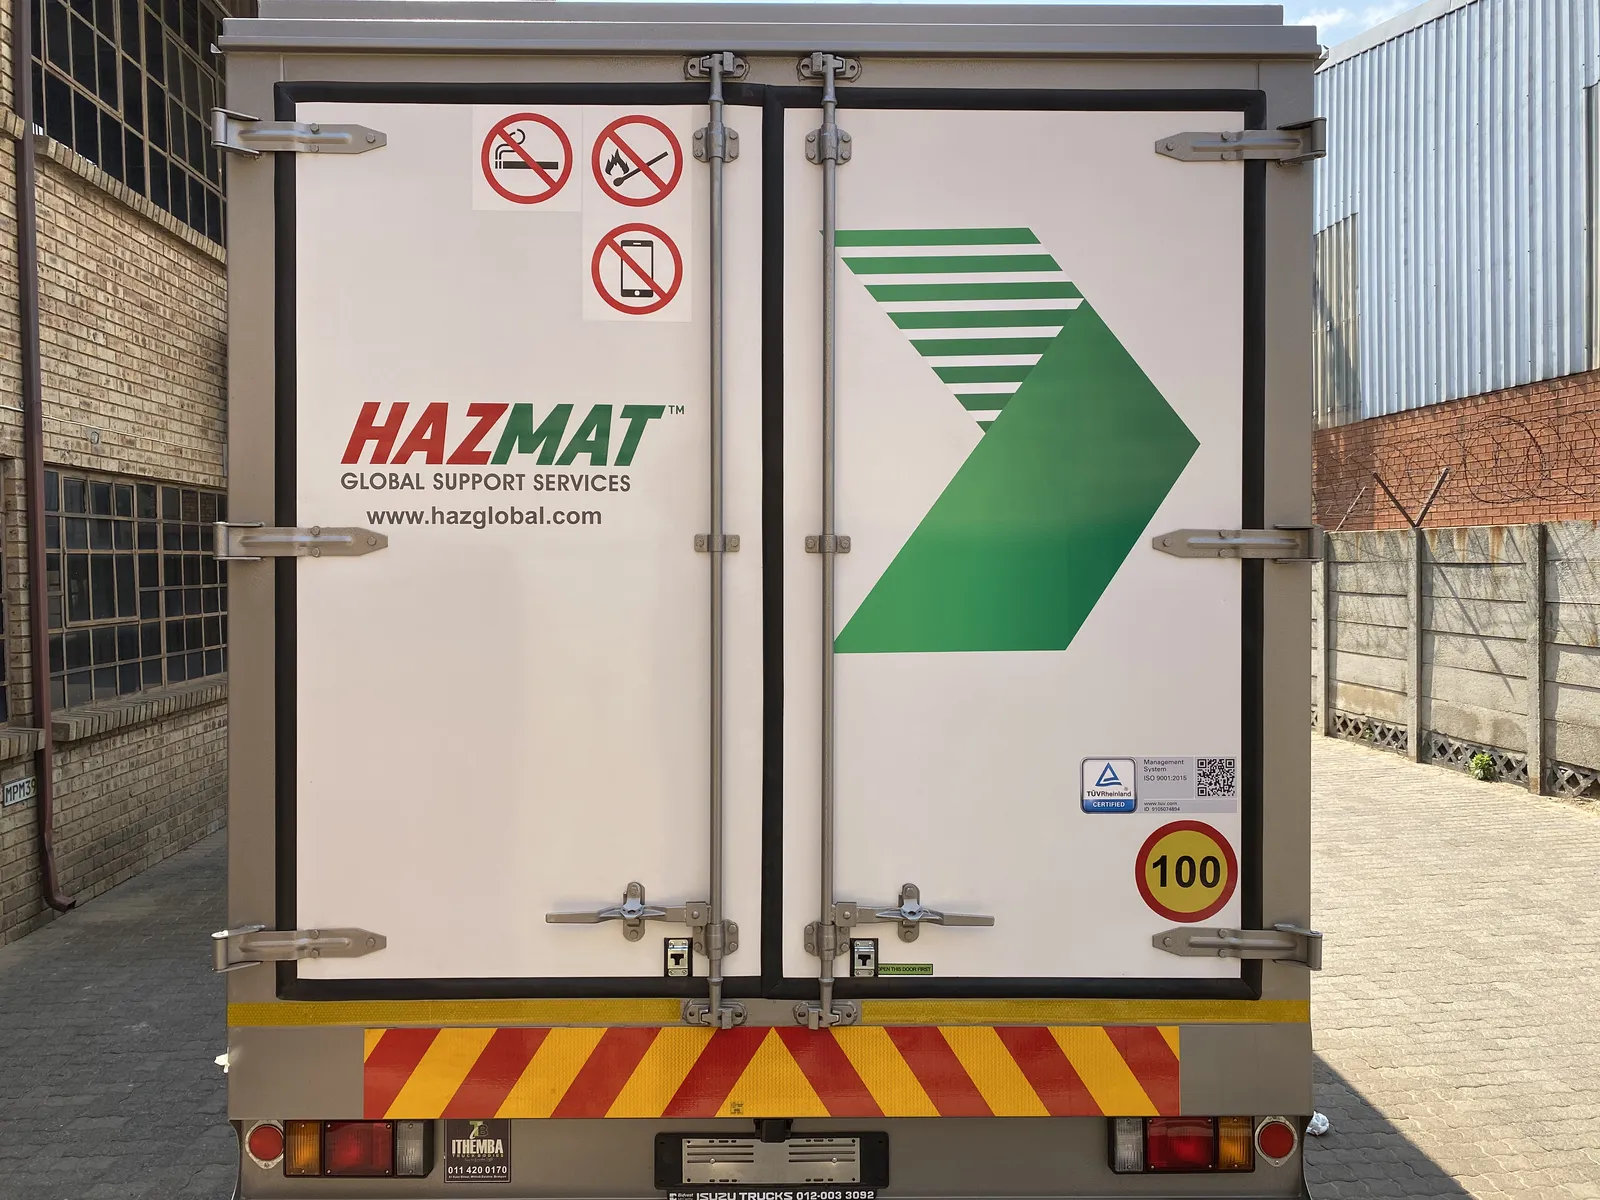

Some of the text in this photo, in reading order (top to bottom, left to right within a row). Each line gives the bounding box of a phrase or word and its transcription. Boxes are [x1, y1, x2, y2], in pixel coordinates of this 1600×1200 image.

[340, 401, 666, 466] HAZMAT
[340, 472, 631, 492] GLOBAL SUPPORT SERVICES
[366, 506, 602, 529] www.hazglobal.com
[1152, 855, 1221, 888] 100
[451, 1139, 504, 1154] ITHEMBA
[448, 1166, 507, 1174] 011 420 0170
[696, 1192, 737, 1200] ISUZU
[739, 1192, 793, 1200] TRUCKS
[796, 1191, 842, 1200] 012-003
[845, 1191, 875, 1200] 3092
